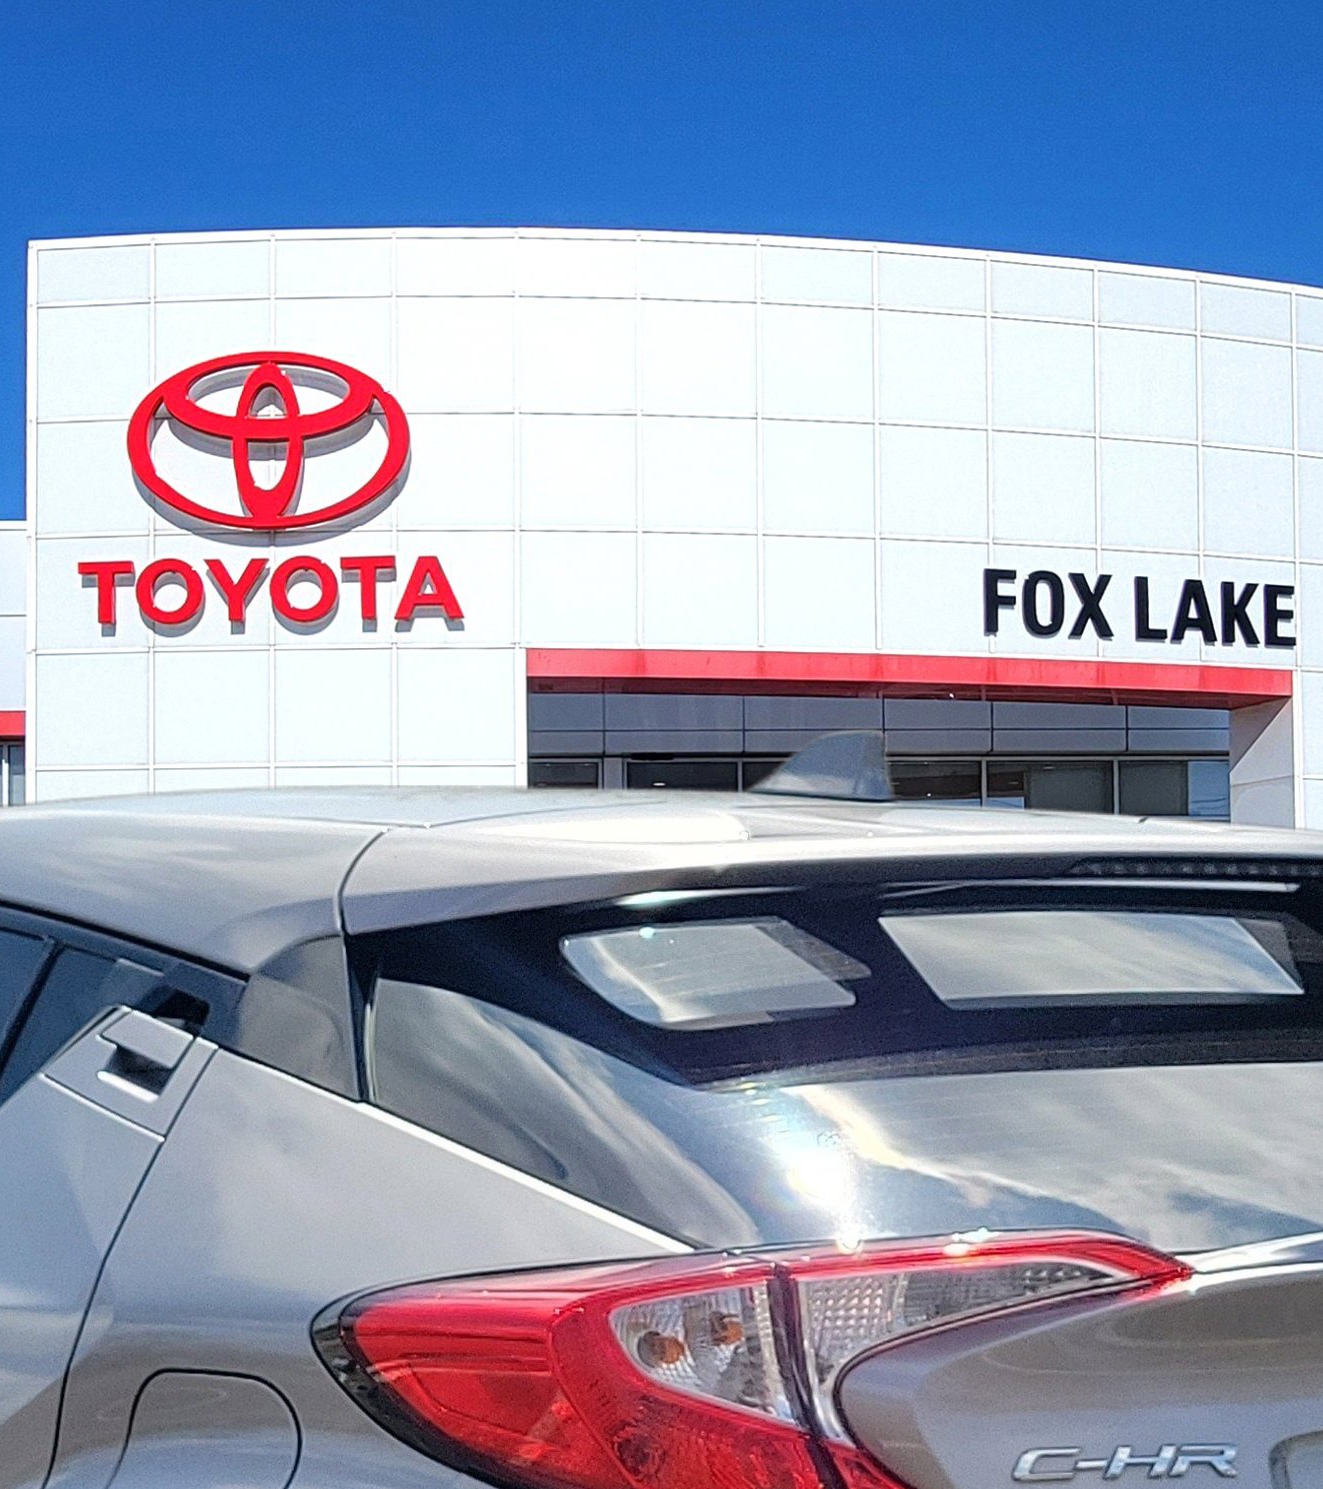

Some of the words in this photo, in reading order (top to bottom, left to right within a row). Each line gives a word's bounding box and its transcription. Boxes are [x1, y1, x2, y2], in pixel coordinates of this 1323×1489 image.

[78, 554, 465, 636] TOYOTA
[984, 567, 1114, 641] FOX
[1134, 576, 1297, 649] LAKE
[1011, 1443, 1238, 1481] C-HR
